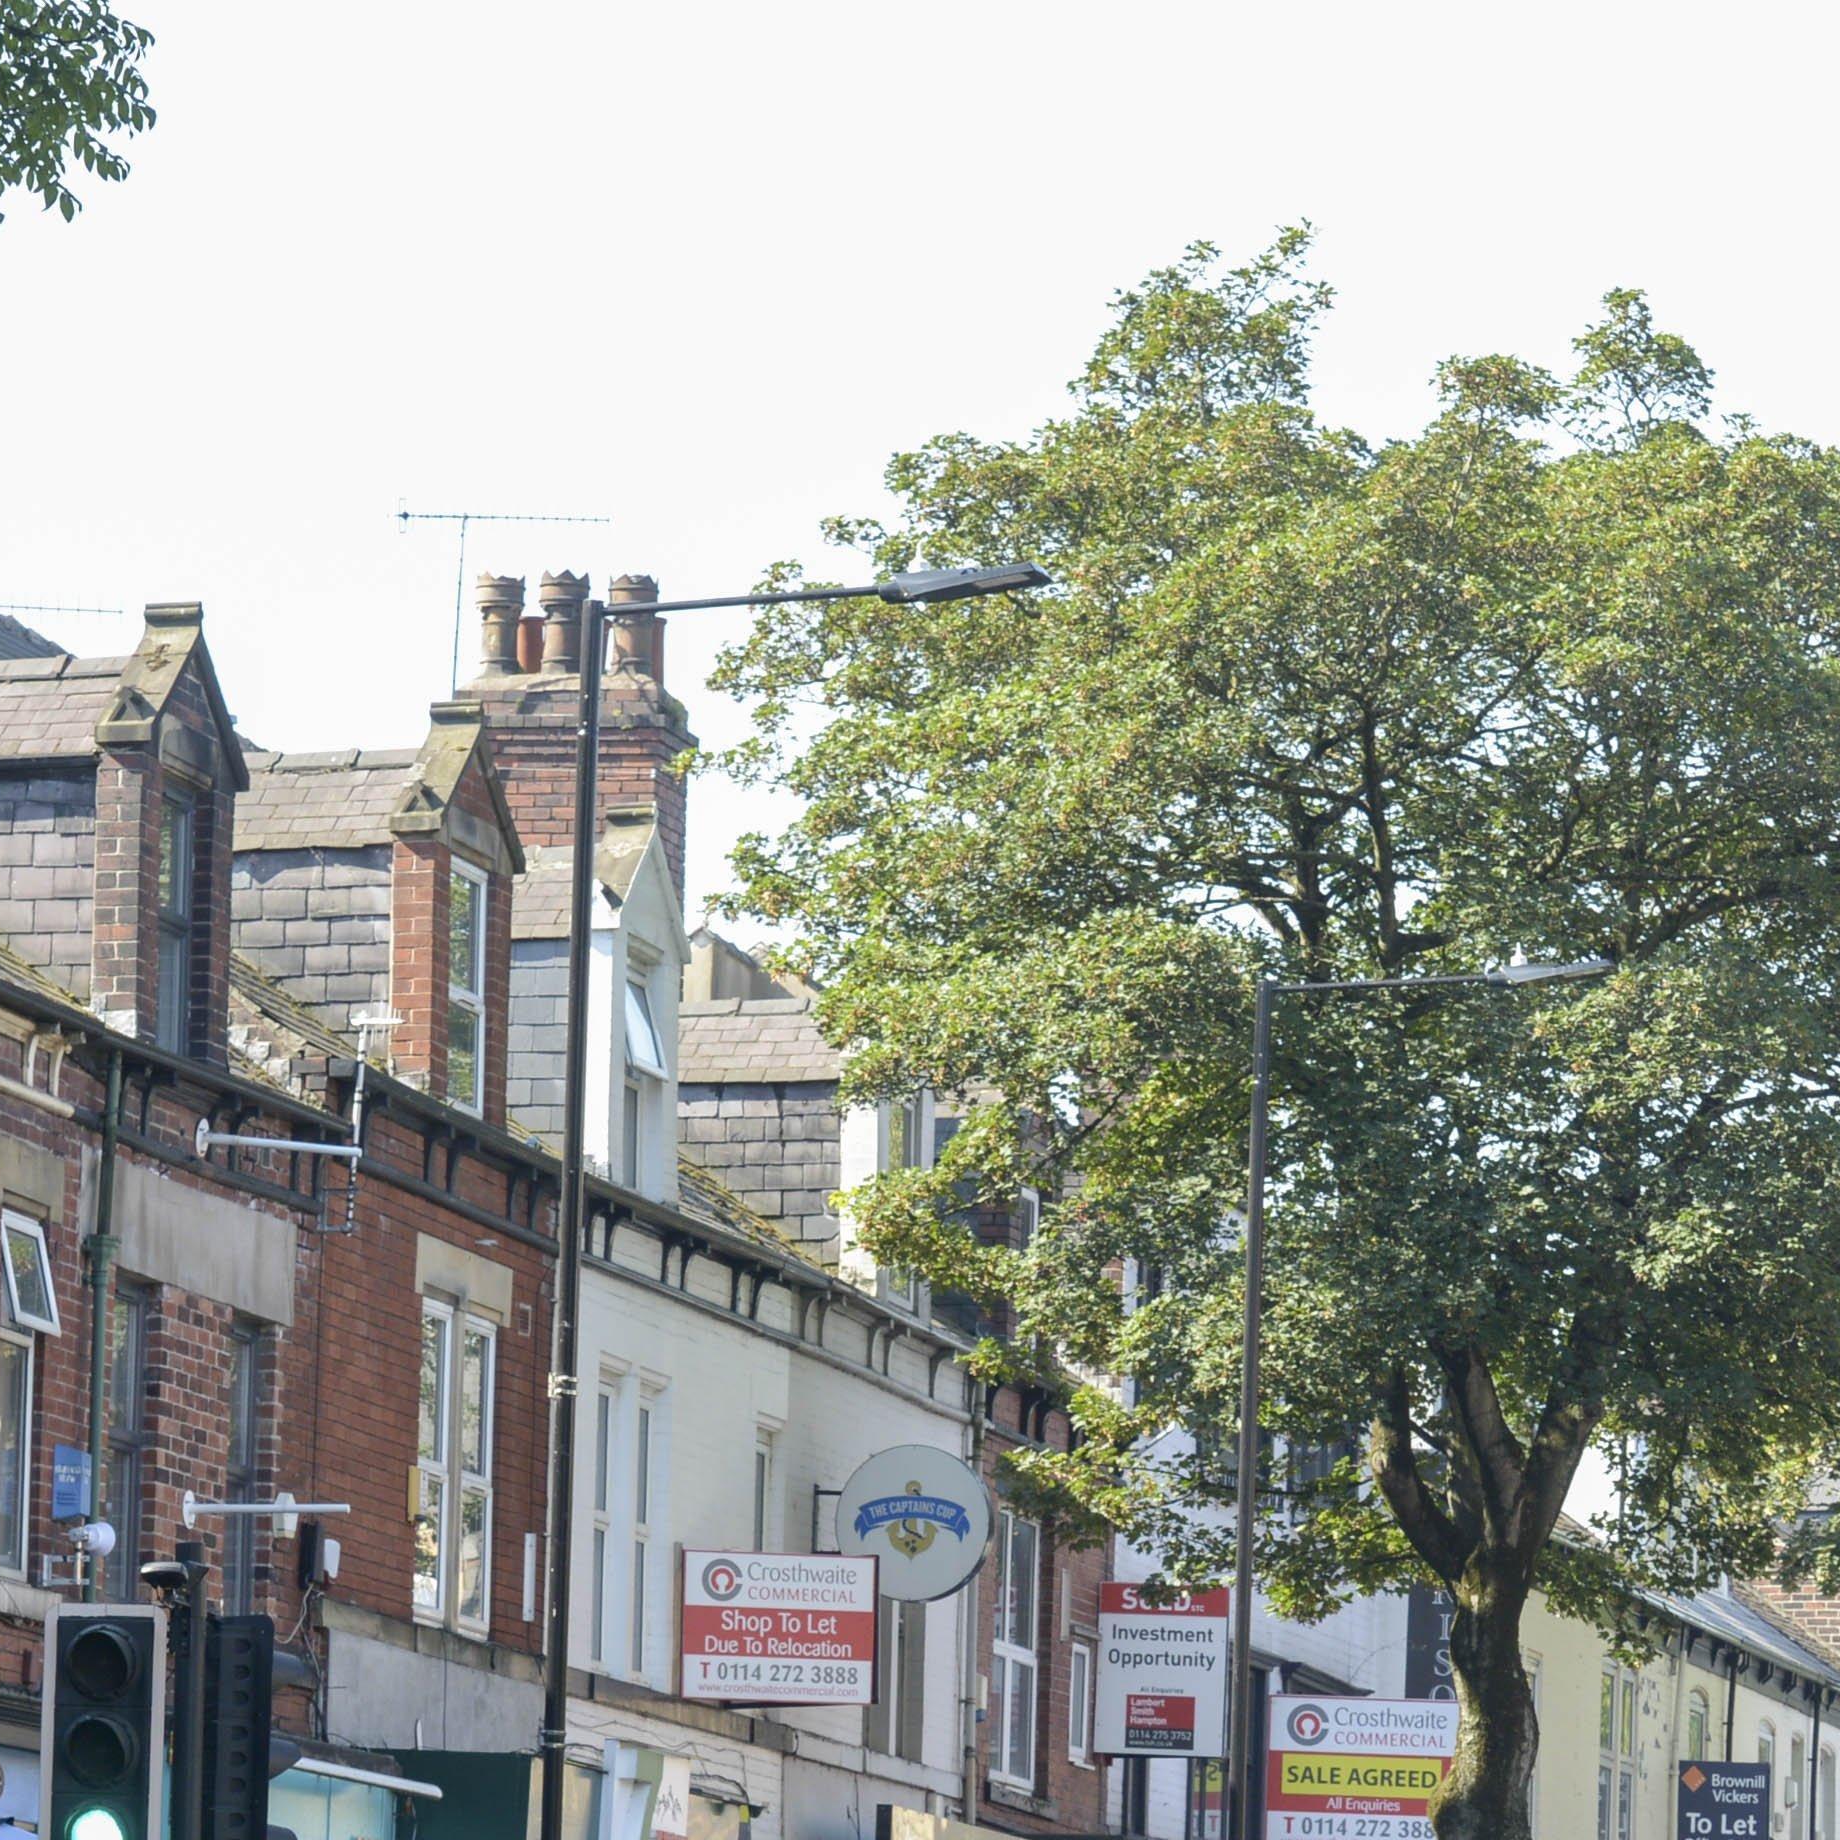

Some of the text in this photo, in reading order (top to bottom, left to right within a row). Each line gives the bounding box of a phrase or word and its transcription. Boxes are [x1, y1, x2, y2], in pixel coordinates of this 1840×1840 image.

[869, 1501, 957, 1520] THE CAPTAINS CUP
[748, 1561, 857, 1585] Crosthwaite
[748, 1586, 857, 1604] COMMERCIAL
[721, 1609, 838, 1637] Shop To Let
[1112, 1624, 1213, 1643] Investment
[705, 1635, 852, 1657] Due To Relocation
[1108, 1648, 1216, 1671] Opportunity
[700, 1662, 858, 1684] T 0114 272 3888
[1334, 1706, 1448, 1729] Crosthwaite
[1334, 1731, 1447, 1748] COMMERCIAL
[1287, 1766, 1438, 1788] SALE AGREED
[1711, 1773, 1765, 1788] Brownill
[1326, 1797, 1400, 1813] All Enquiries
[1712, 1789, 1759, 1804] Vickers
[1284, 1816, 1434, 1839] T 0114 272 388
[1686, 1812, 1757, 1836] To Let
